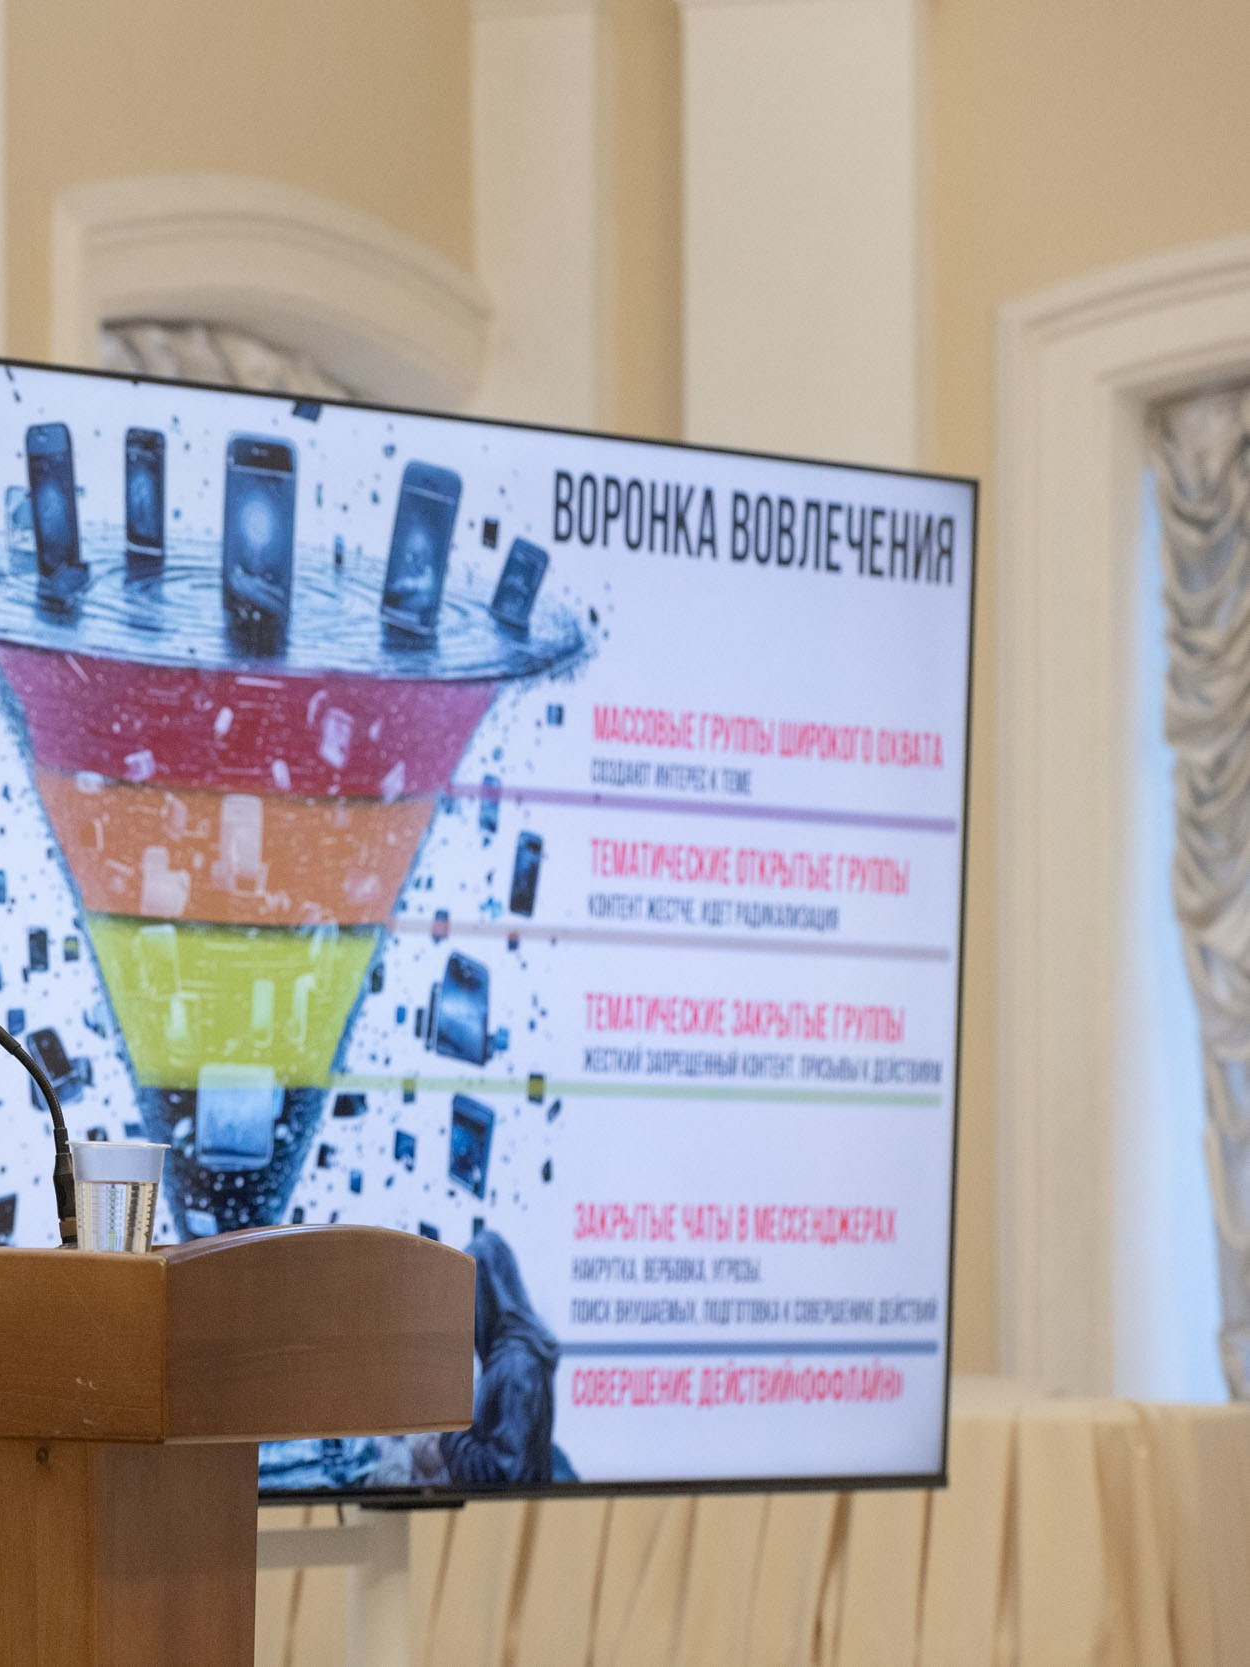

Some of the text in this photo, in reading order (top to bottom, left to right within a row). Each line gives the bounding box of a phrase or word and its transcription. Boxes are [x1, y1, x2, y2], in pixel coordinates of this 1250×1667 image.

[553, 470, 955, 585] ВОРОНКА ВОВЛЕЧЕНИЯ
[593, 705, 943, 767] МАССОВЫЕ ГРУППЫ ШИРОКОГО ОХВАТА
[590, 838, 910, 895] ТЕМАТИЧЕСКИЕ ОТКРЫТЫЕ ГРУППЫ
[585, 992, 904, 1042] ТЕМАТИЧЕСКИЕ ЗАКРЫТЫЕ ГРУППЫ
[574, 1203, 897, 1245] ЗАКРЫТЫЕ ЧАТЫ В МЕССЕНДЖЕРАХ
[571, 1368, 693, 1406] СОВЕРШЕНИЕ
